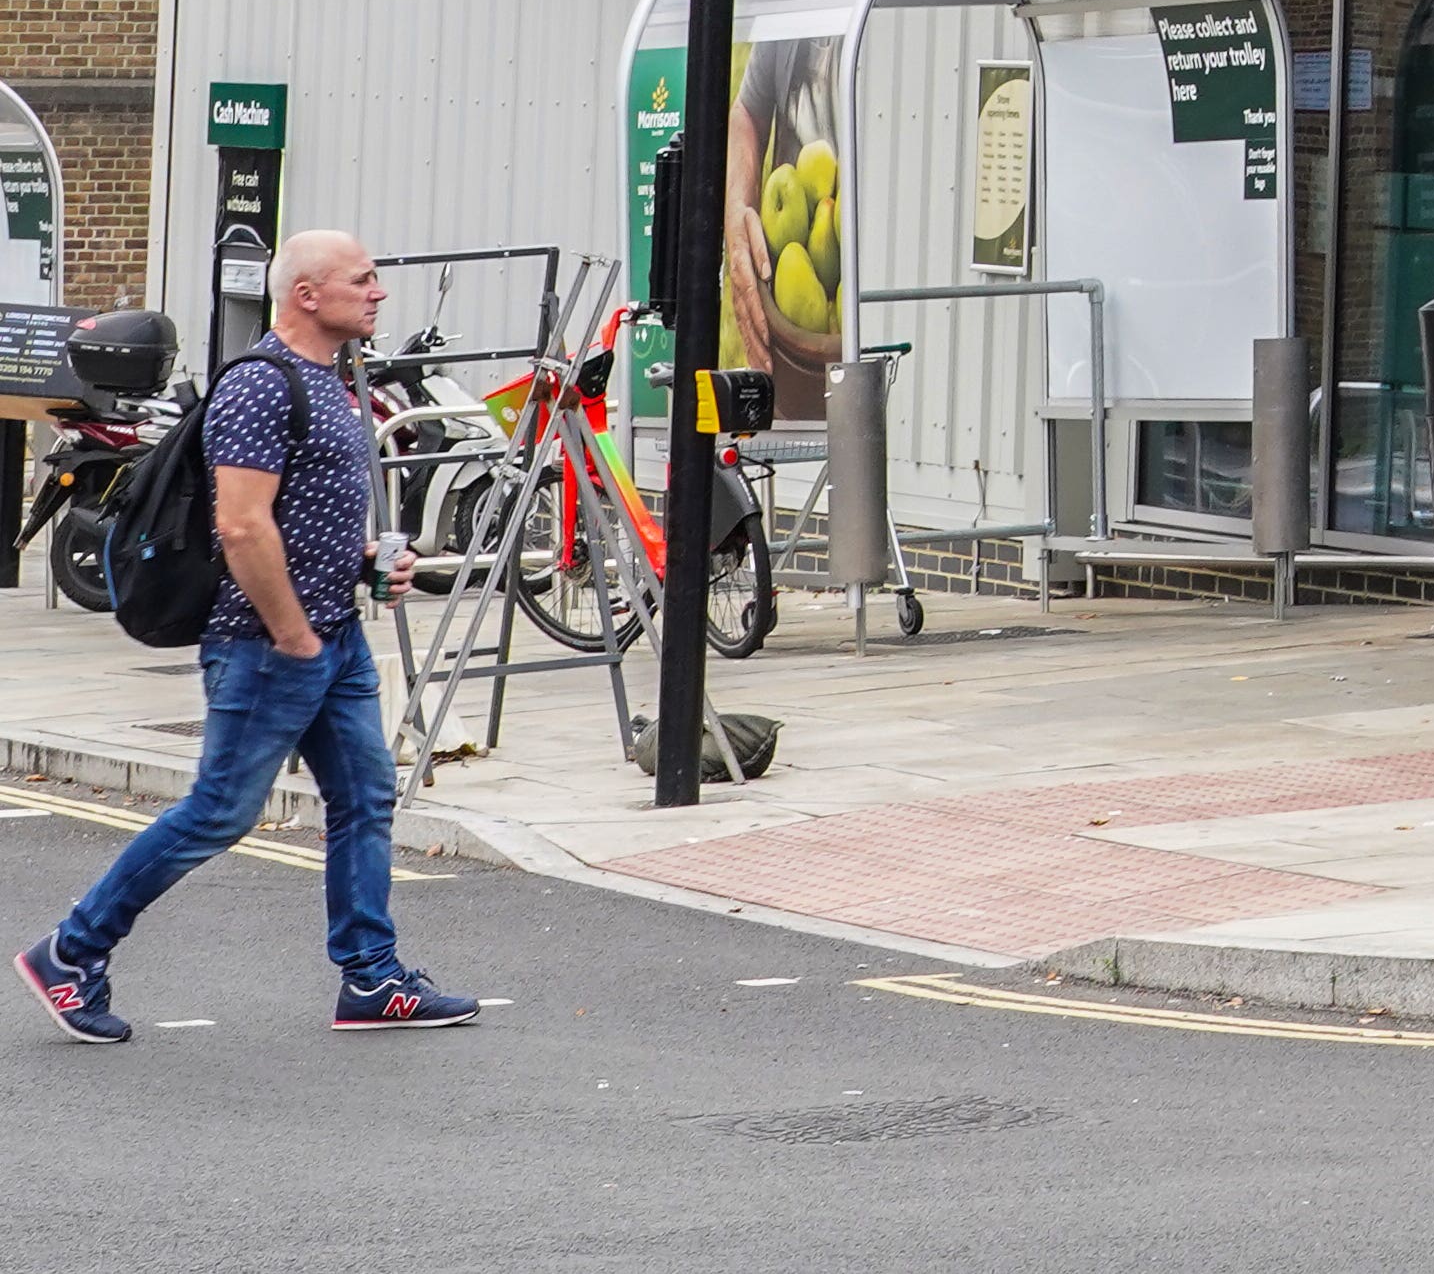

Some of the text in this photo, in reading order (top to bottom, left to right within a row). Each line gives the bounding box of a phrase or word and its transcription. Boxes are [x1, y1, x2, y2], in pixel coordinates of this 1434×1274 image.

[1158, 11, 1258, 41] Please collect and
[1167, 42, 1265, 75] return your trolley
[1171, 79, 1197, 102] here
[213, 100, 270, 126] Cash Machine
[637, 110, 681, 130] Morrisons
[1243, 108, 1276, 128] Thank you
[231, 170, 259, 187] Free cash
[226, 194, 262, 213] withdrawals
